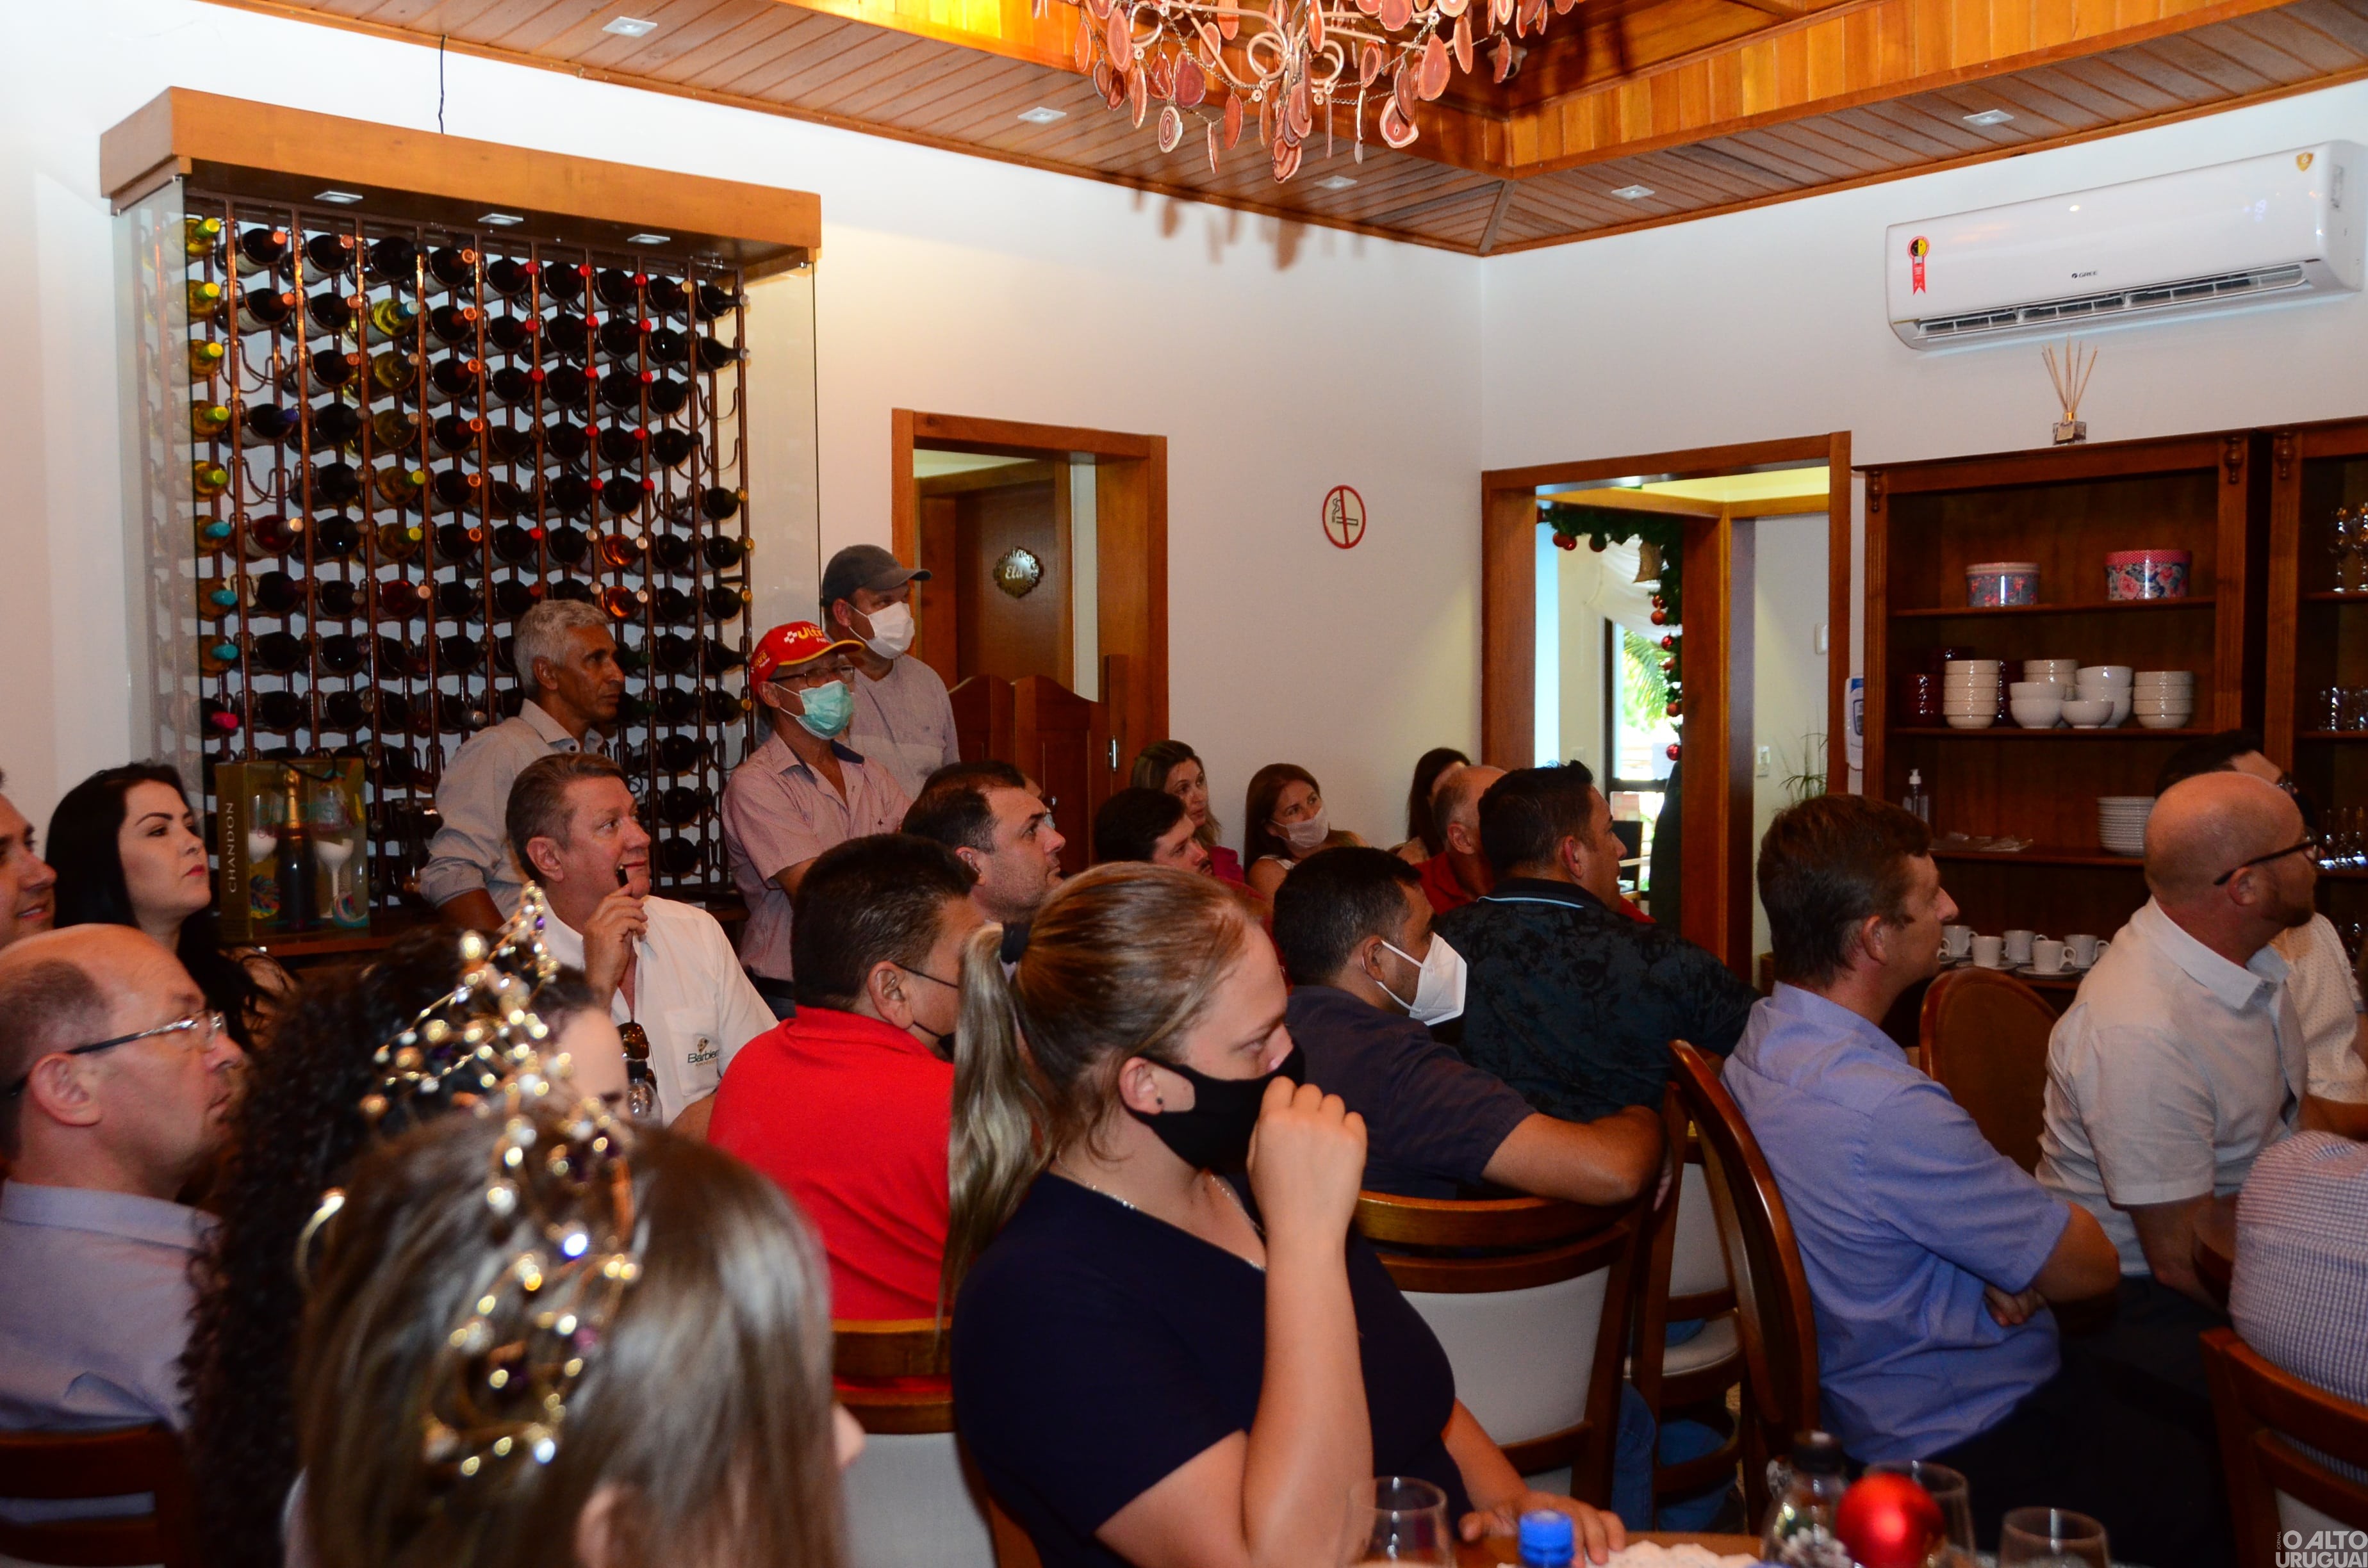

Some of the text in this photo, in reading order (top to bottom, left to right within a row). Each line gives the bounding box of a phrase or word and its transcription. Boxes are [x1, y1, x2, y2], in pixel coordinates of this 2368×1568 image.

[1005, 565, 1024, 580] Ela
[797, 626, 823, 639] Ultr
[226, 802, 237, 893] CHANDON
